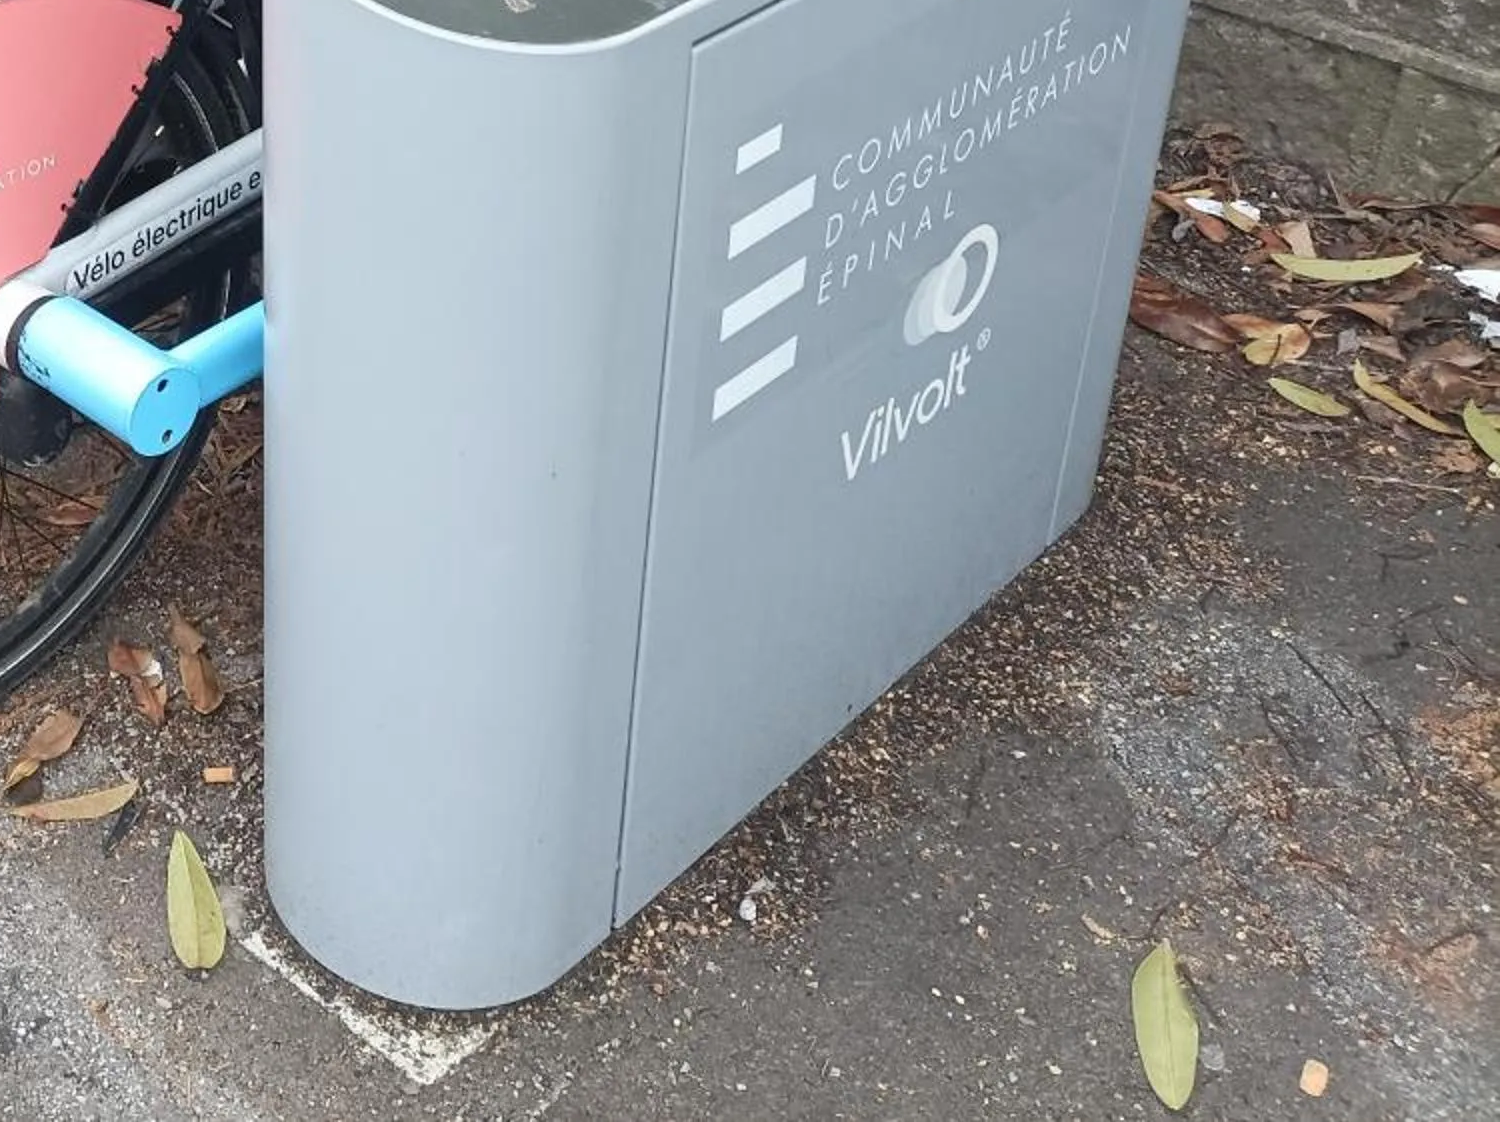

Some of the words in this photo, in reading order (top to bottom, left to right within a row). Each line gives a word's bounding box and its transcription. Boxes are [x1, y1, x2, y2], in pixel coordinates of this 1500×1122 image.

[825, 24, 1132, 248] D'AGGLOMÉRATION
[833, 9, 1072, 191] COMMUNAUTÉ
[73, 249, 125, 289] Vélo
[131, 181, 243, 258] électrique
[817, 189, 955, 305] ÉPINAL
